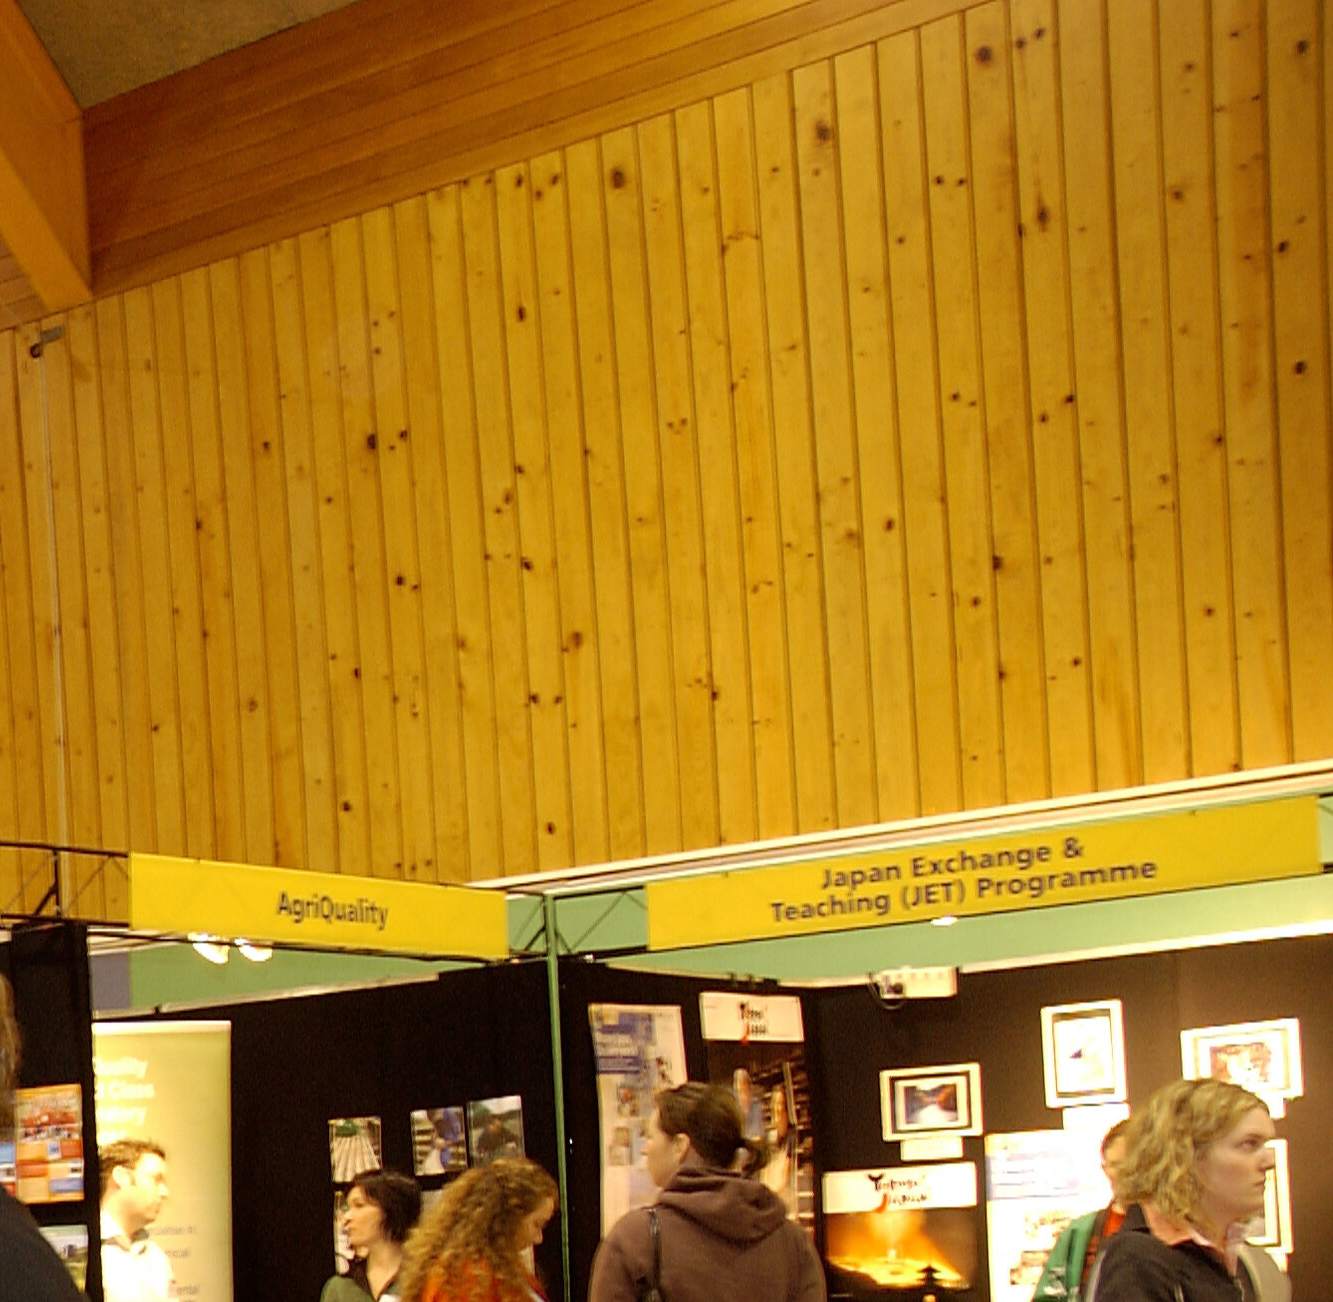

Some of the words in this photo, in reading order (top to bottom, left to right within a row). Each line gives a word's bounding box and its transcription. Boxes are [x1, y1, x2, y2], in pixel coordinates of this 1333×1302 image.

[821, 865, 902, 890] Japan
[911, 846, 1051, 877] Exchange
[1063, 836, 1083, 859] &
[277, 891, 389, 931] AgriQuality
[770, 892, 891, 922] Teaching
[901, 879, 966, 911] (JET)
[977, 862, 1157, 899] Programme
